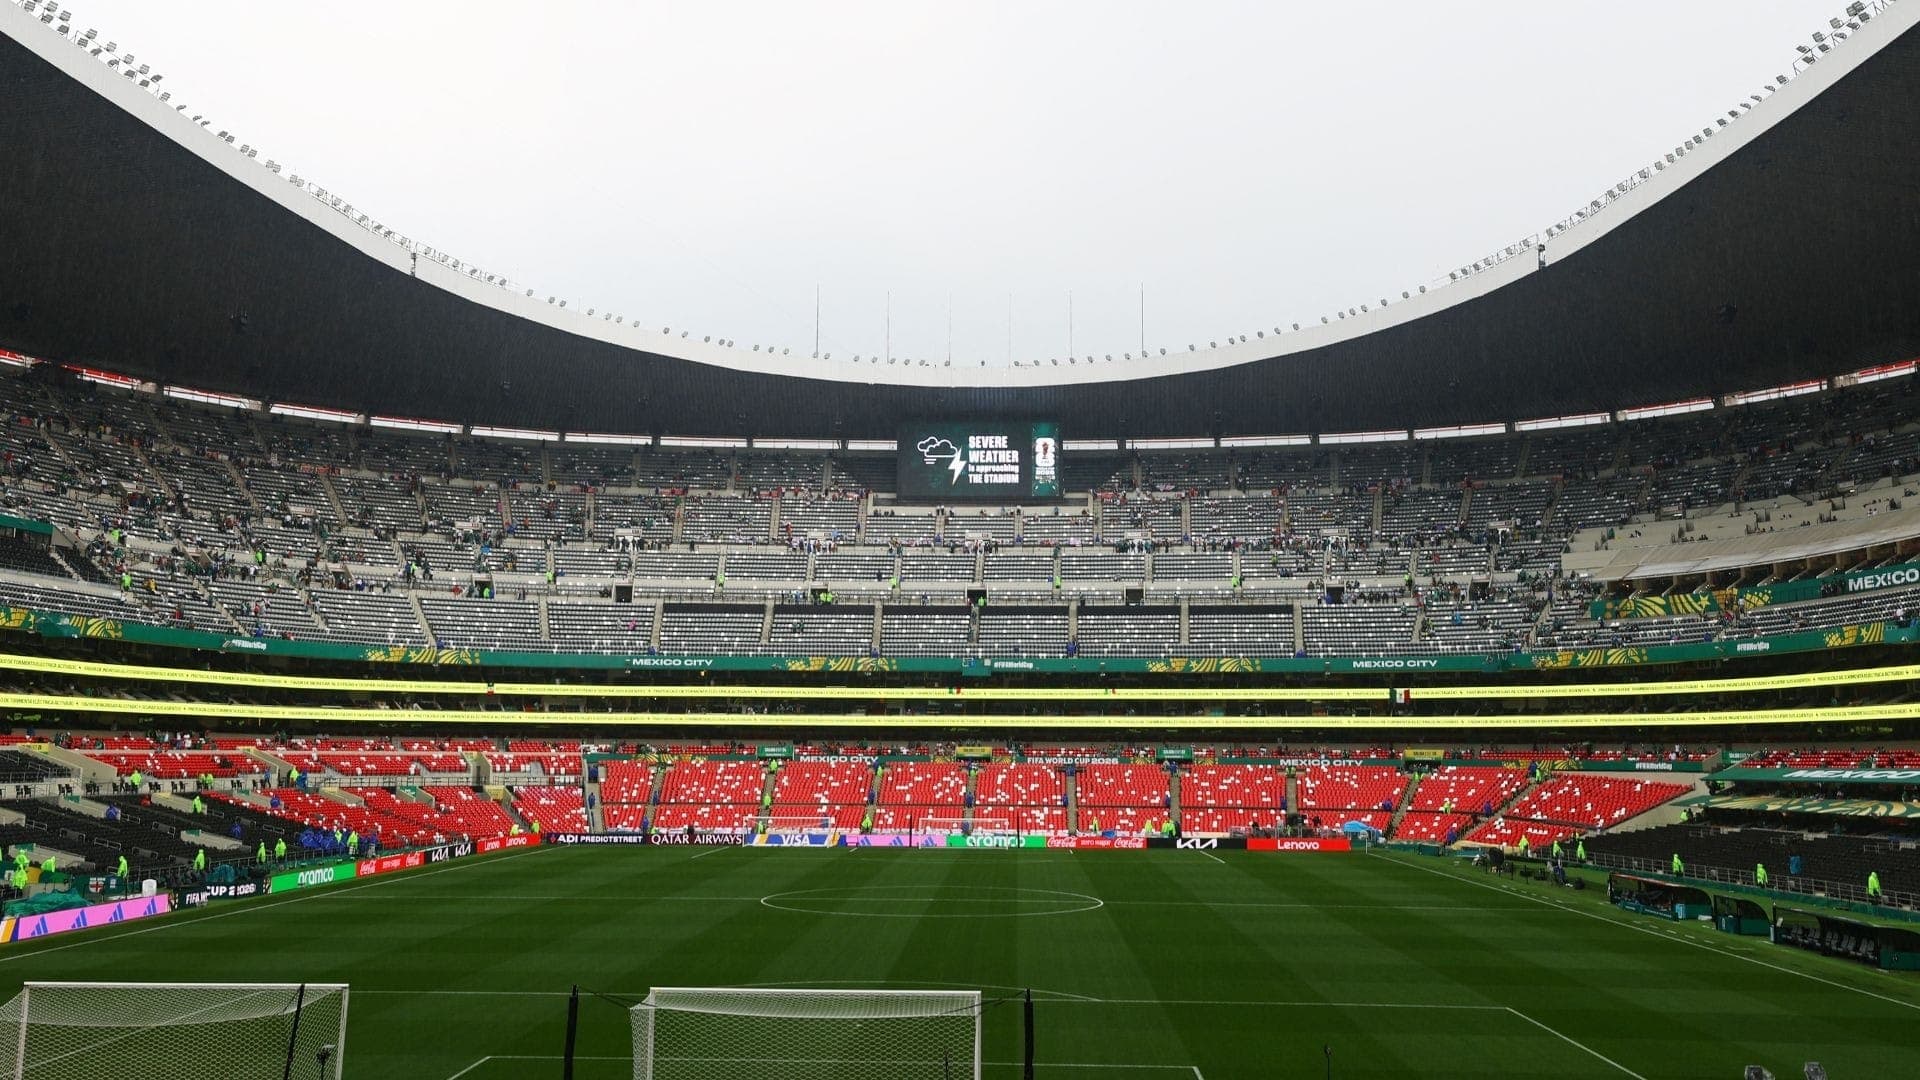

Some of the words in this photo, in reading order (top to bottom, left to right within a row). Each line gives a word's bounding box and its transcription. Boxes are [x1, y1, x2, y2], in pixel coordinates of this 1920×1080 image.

[968, 436, 1008, 448] SEVERE
[968, 450, 1019, 462] WEATHER
[968, 464, 974, 472] is
[976, 464, 1019, 474] approaching
[968, 474, 982, 483] THE
[984, 474, 1019, 483] STADIUM
[1848, 568, 1920, 592] MEXICO
[994, 660, 1034, 669] #FIFAWorldCup
[1782, 770, 1920, 778] MEXICO
[484, 840, 500, 850] Lenovo
[506, 836, 527, 846] Lenovo
[558, 834, 578, 843] ADI
[652, 833, 689, 845] QATAR
[694, 833, 742, 844] AIRWAYS
[781, 834, 810, 845] VISA
[966, 836, 1025, 847] aramco
[1047, 837, 1076, 848] Coca-Cola
[1114, 837, 1144, 848] Coca-Cola
[1176, 838, 1218, 849] KIA
[1278, 840, 1319, 850] Lenovo
[432, 846, 449, 862] KIA
[455, 844, 471, 857] KIA
[298, 867, 334, 886] aramco
[186, 892, 199, 904] FIFA
